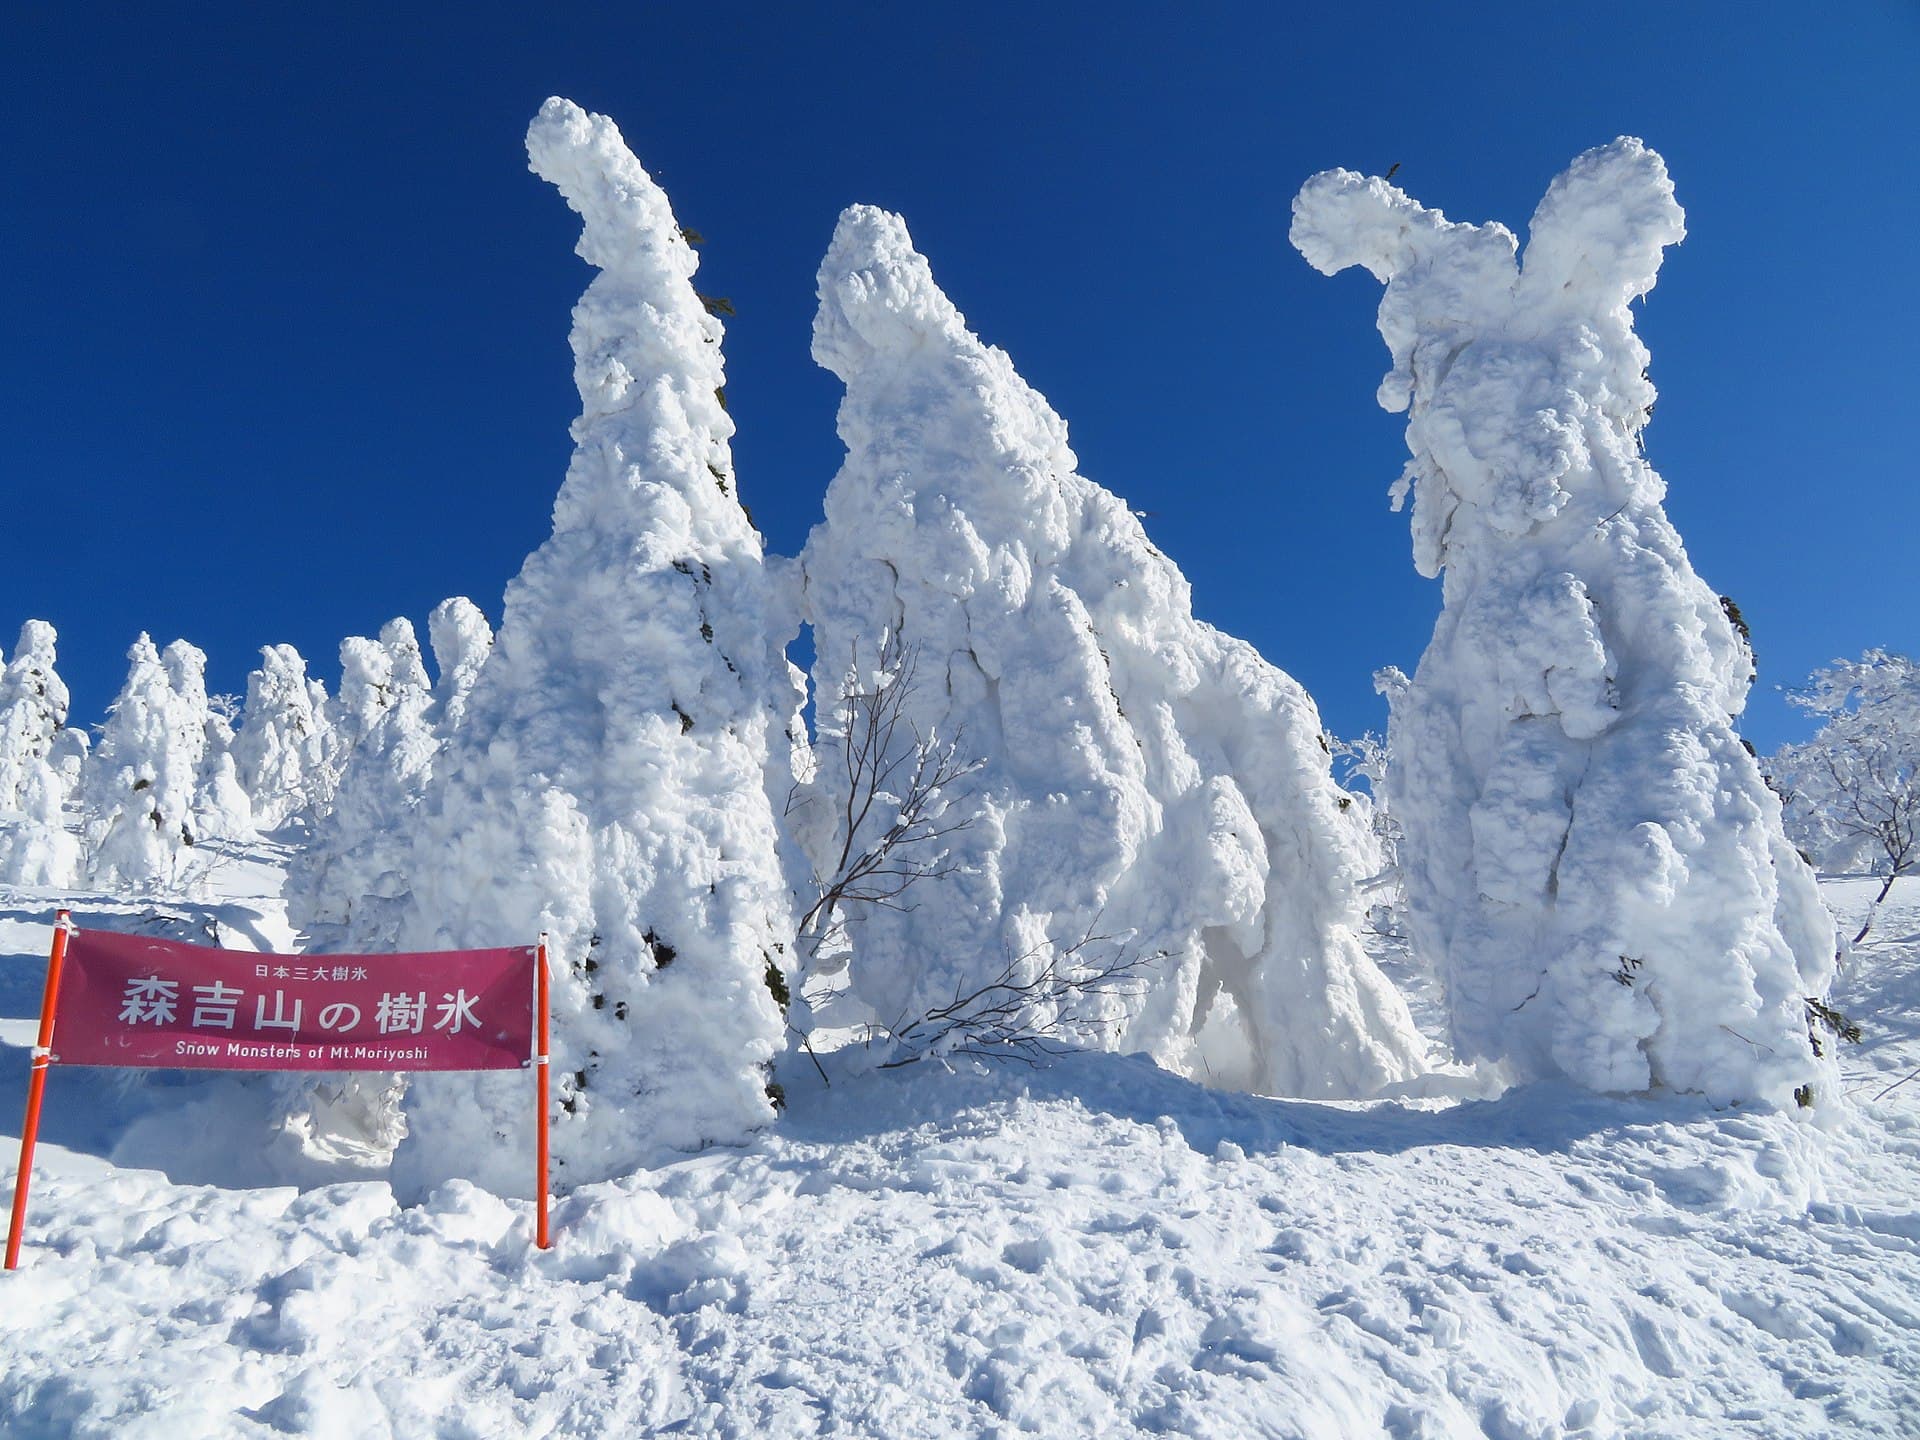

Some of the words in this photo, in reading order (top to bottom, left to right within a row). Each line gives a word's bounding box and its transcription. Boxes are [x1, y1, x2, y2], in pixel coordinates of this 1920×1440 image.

[254, 963, 368, 982] 日本三大樹氷
[117, 975, 483, 1034] 森吉山の樹氷
[175, 1040, 220, 1056] Snow
[226, 1042, 301, 1059] Monsters
[308, 1046, 324, 1060] of
